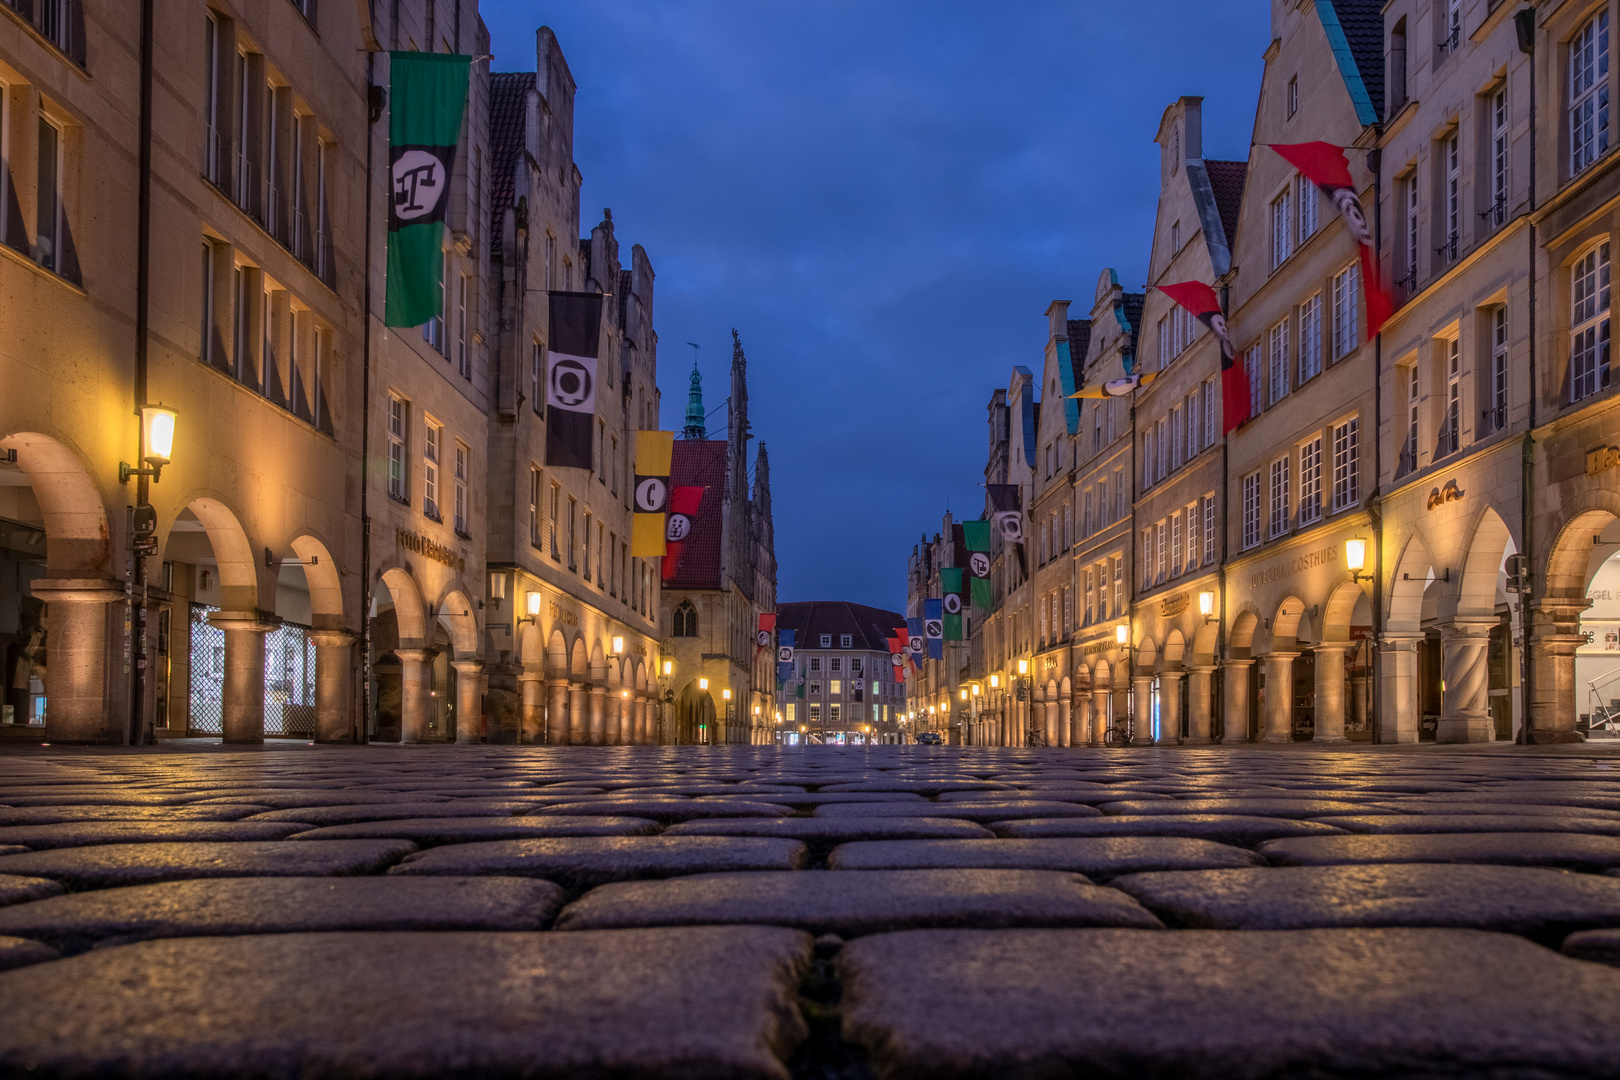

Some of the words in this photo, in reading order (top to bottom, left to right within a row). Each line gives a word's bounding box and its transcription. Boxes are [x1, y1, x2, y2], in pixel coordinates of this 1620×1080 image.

[396, 528, 420, 553] FOTO
[1251, 564, 1284, 590] JUWELIER
[1298, 545, 1338, 571] OSTHUES
